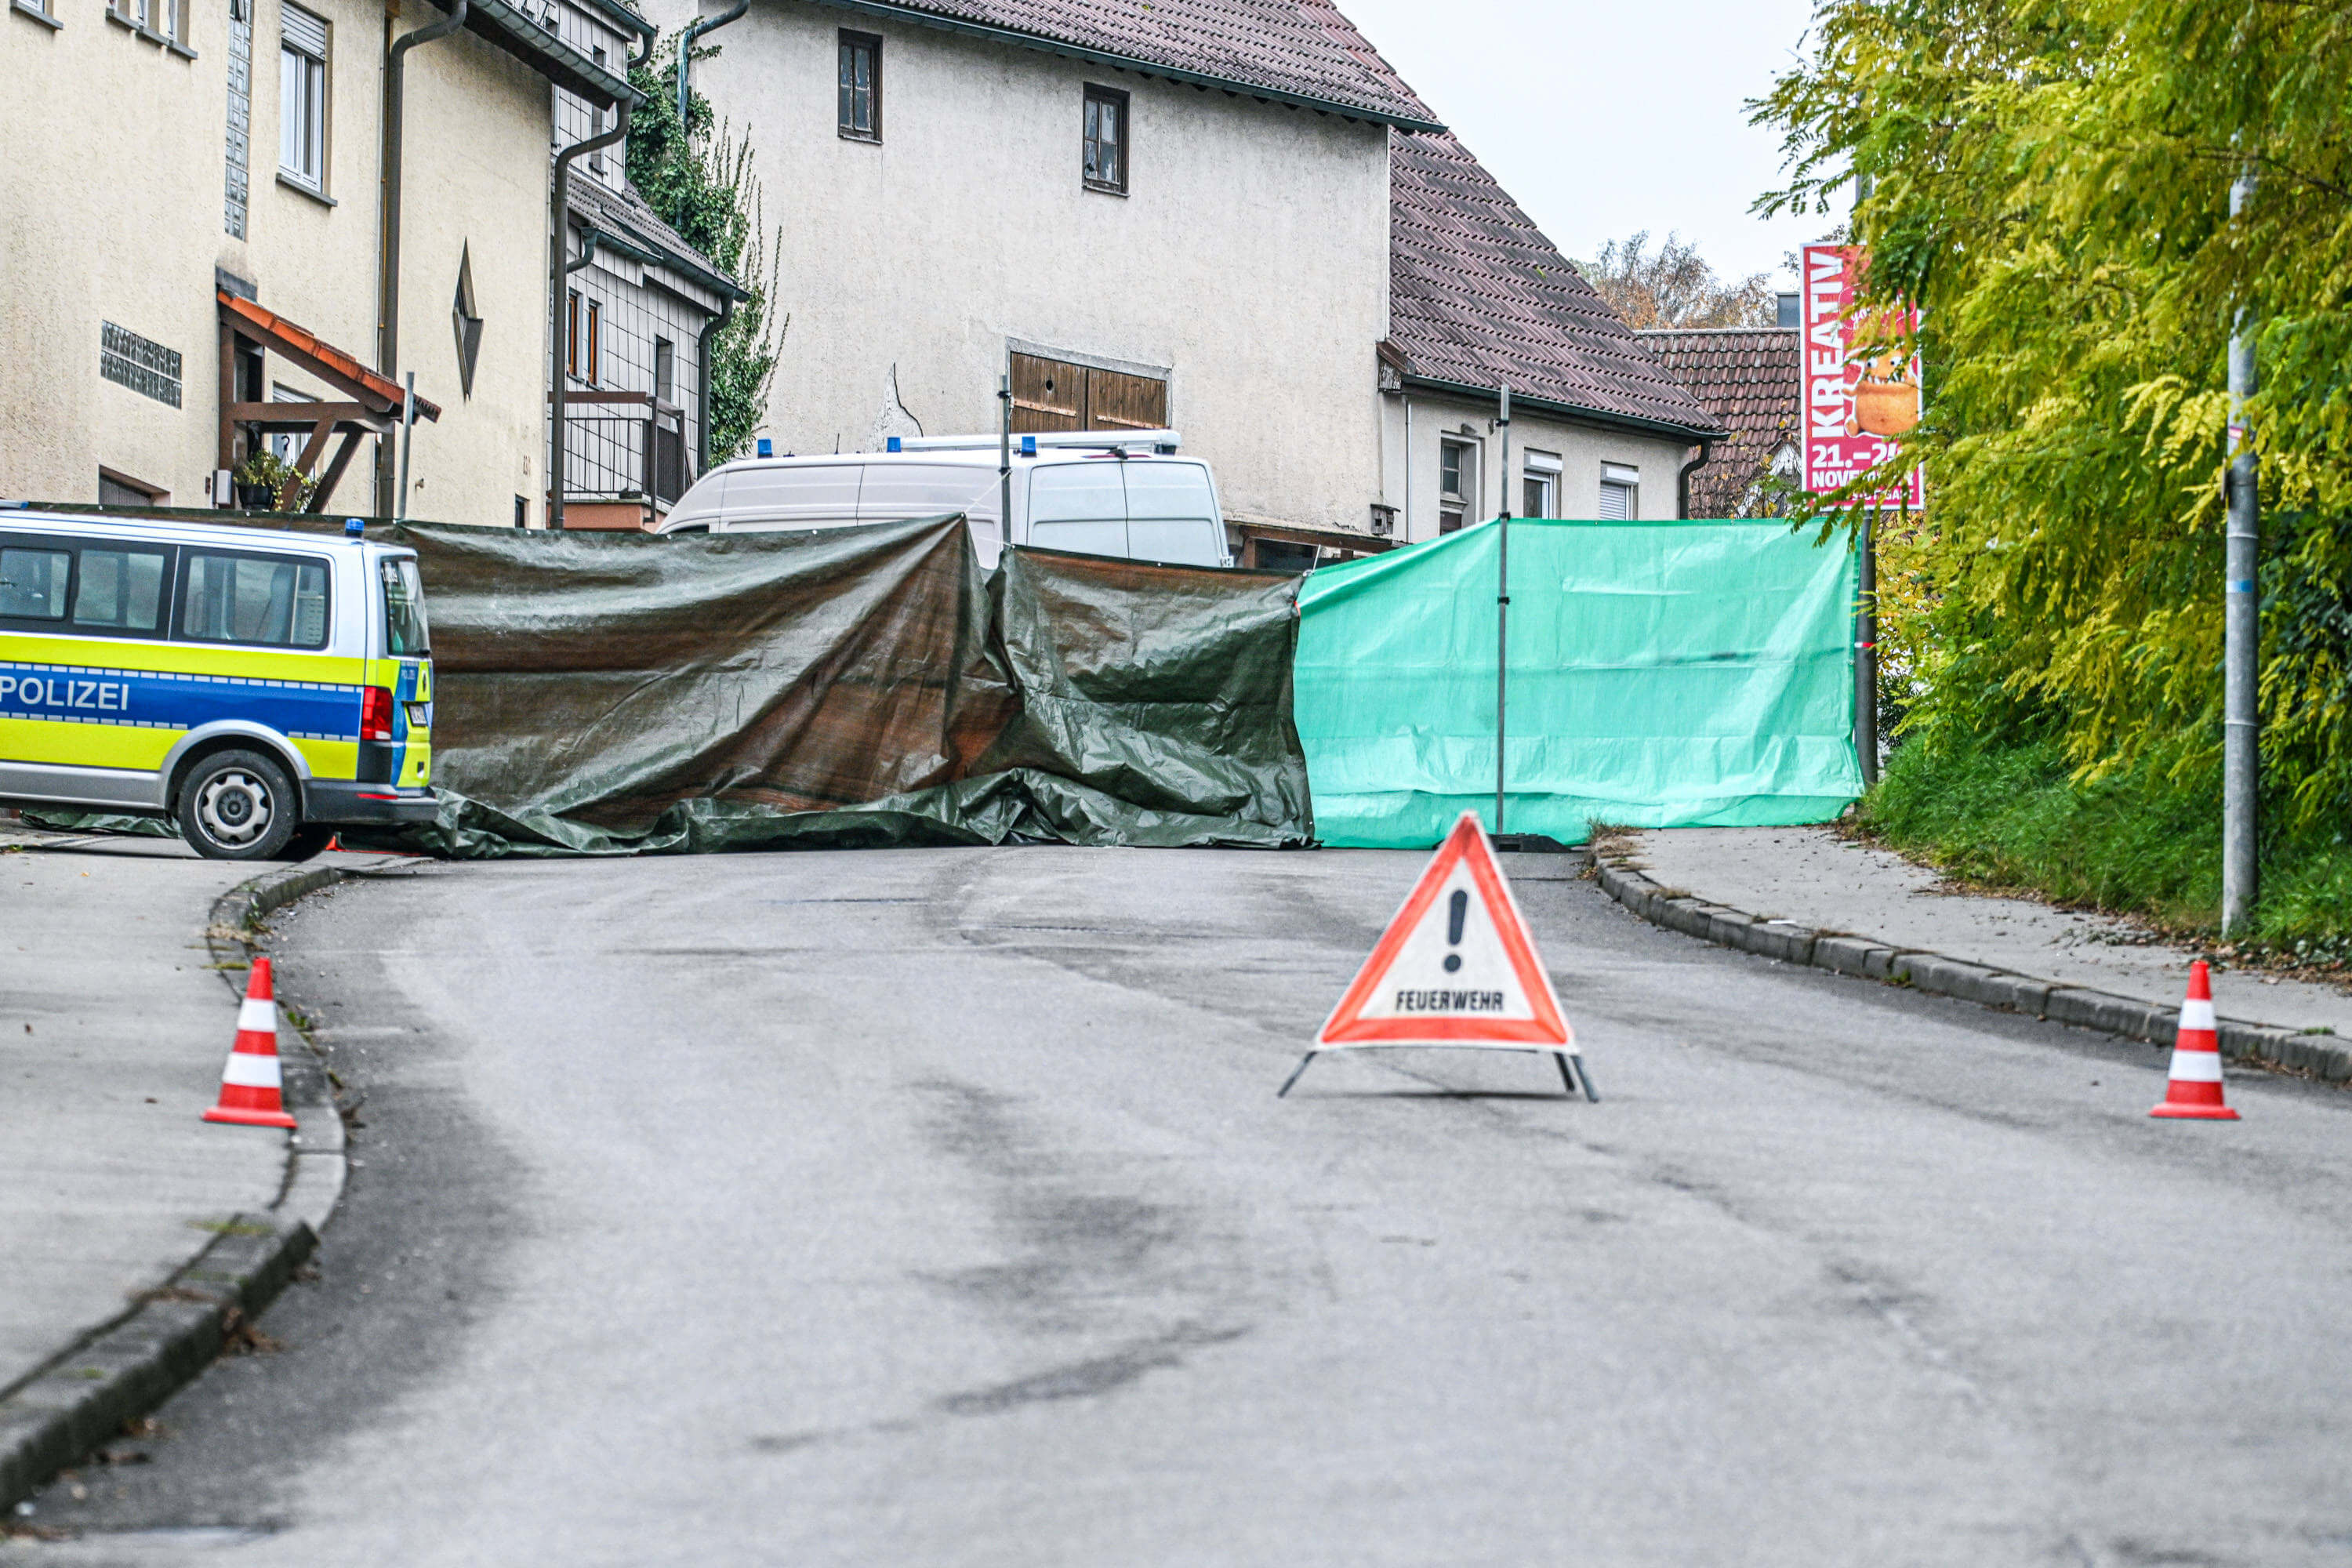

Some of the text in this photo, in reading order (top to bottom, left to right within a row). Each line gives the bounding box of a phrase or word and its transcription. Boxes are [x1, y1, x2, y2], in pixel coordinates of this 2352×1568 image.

[1810, 251, 1844, 437] KREATIV
[0, 676, 129, 710] POLIZEI
[1396, 990, 1504, 1011] FEUERWEHR
